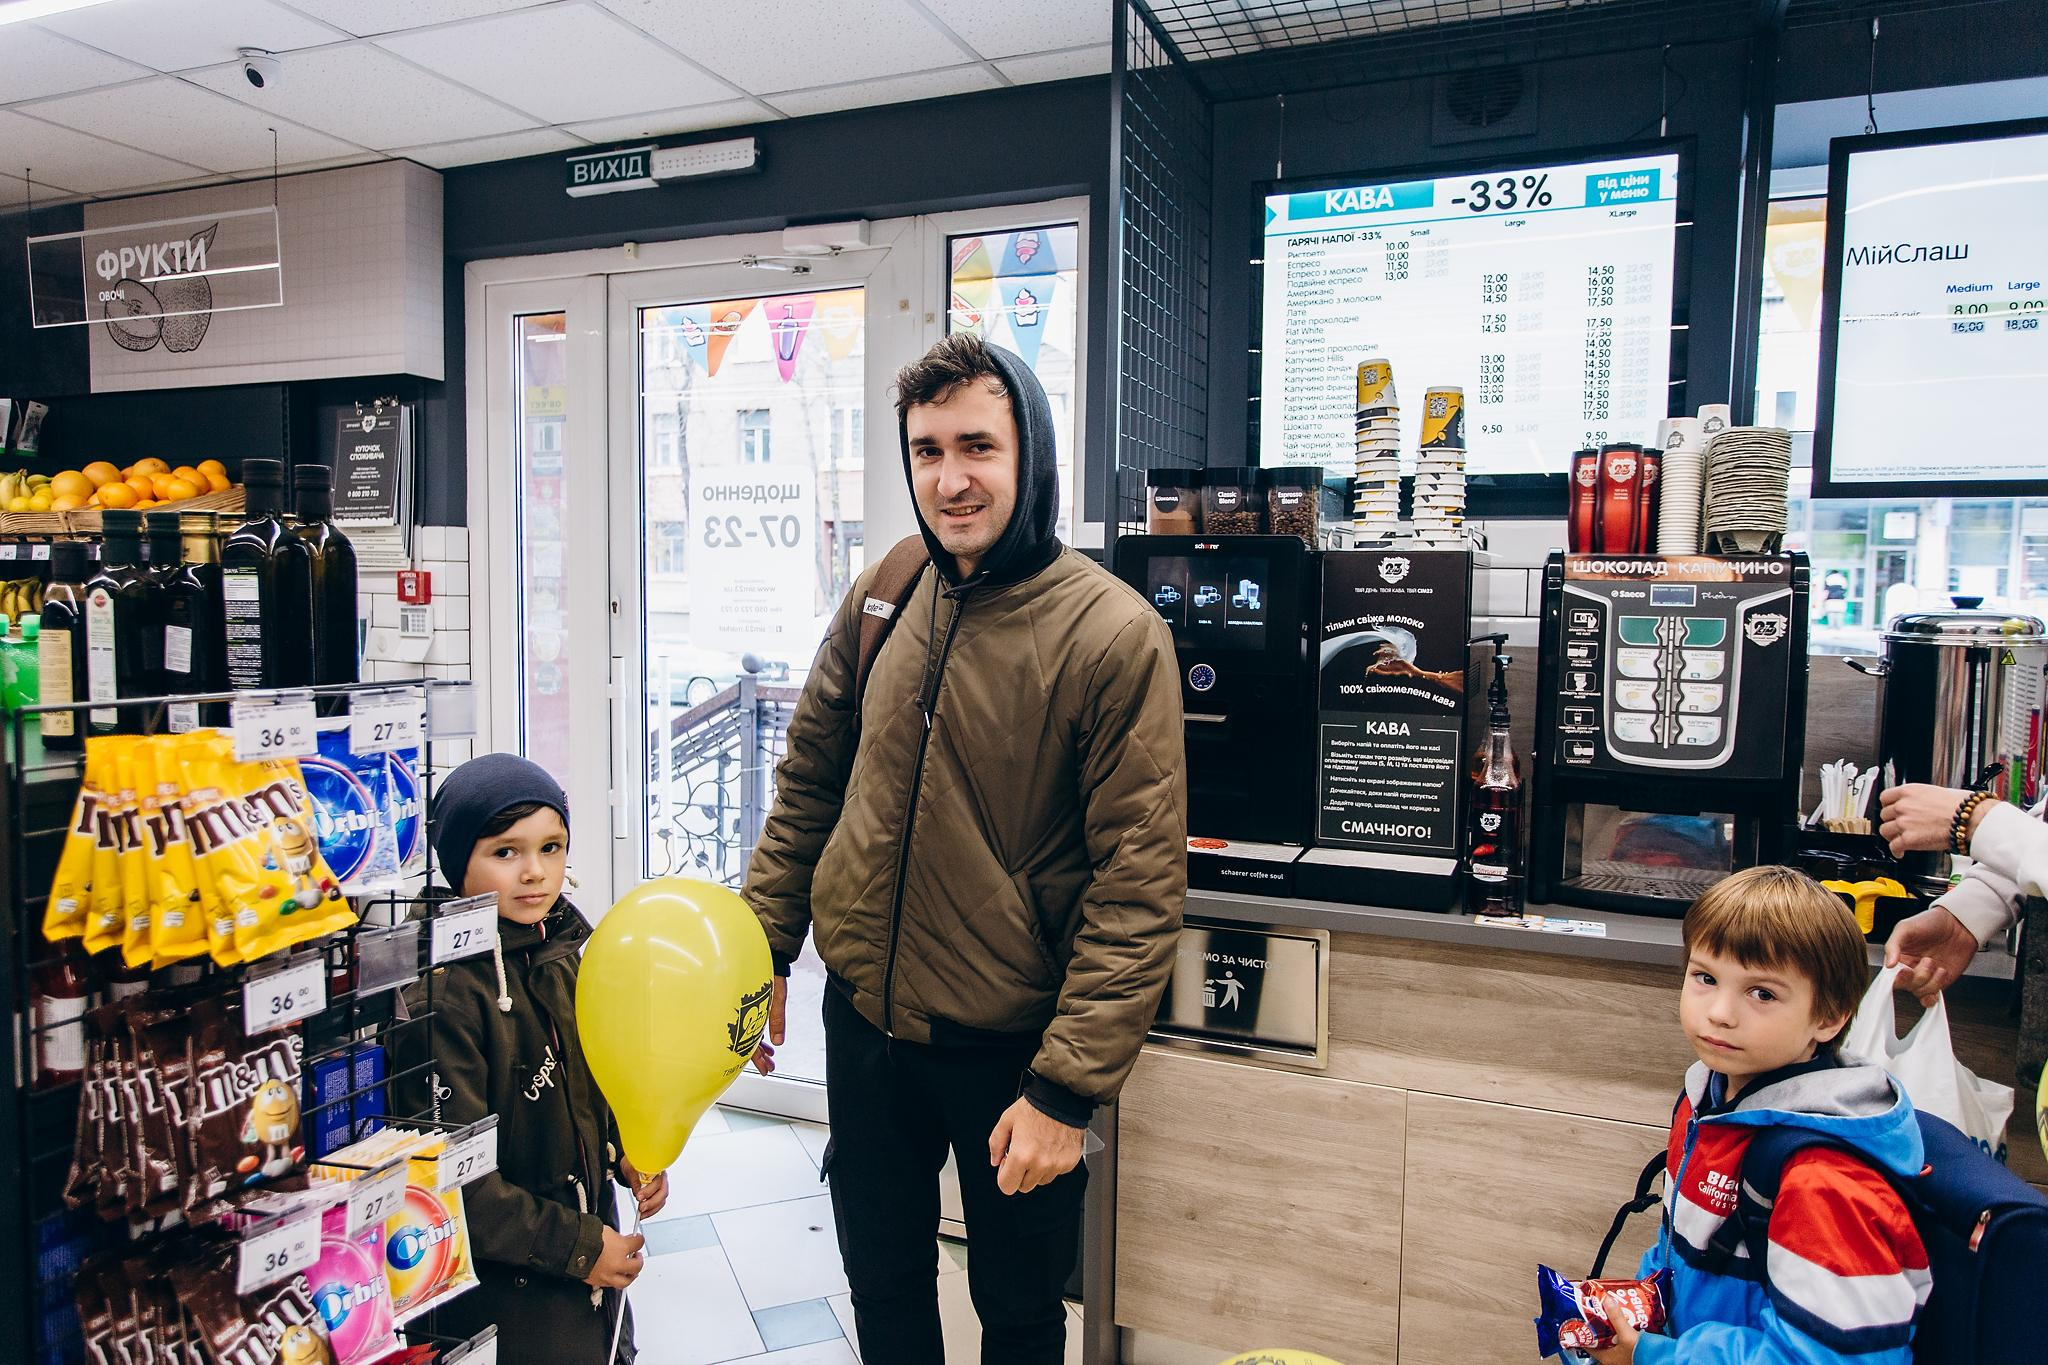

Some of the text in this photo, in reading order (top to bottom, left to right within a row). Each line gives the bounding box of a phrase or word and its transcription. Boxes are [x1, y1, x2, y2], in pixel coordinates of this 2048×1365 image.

[574, 155, 644, 184] ВИХІД
[1597, 174, 1650, 190] від ціни
[1451, 173, 1552, 212] -33%
[1600, 187, 1650, 203] у меню
[1324, 186, 1395, 214] КАВА
[1609, 208, 1637, 218] XLarge
[1504, 218, 1526, 228] Large
[1288, 231, 1382, 247] ГАРЯЧІ НАПОЇ -33%
[1410, 229, 1430, 237] Small
[96, 238, 206, 280] ФРУКТИ
[1846, 243, 1969, 268] МійСлаш
[1588, 265, 1614, 276] 14,50
[1483, 273, 1508, 284] 12,00
[1588, 276, 1614, 286] 16,00
[1483, 284, 1508, 294] 13,00
[1588, 286, 1614, 297] 17,50
[1946, 280, 2041, 294] Medium Large
[99, 290, 124, 302] ОВОЧІ
[1587, 296, 1614, 308] 17,50
[1482, 314, 1506, 324] 17,50
[1586, 317, 1612, 328] 17,50
[1952, 318, 2038, 333] 16,00 18,00
[1585, 348, 1611, 359] 14,50
[1584, 359, 1610, 369] 14,50
[1584, 369, 1610, 380] 14,50
[1584, 390, 1610, 400] 14,50
[1584, 400, 1609, 410] 17,50
[1582, 410, 1608, 420] 17,50
[1482, 424, 1502, 435] 9,50
[1586, 431, 1608, 442] 9,50
[1278, 491, 1302, 500] Espresso
[1573, 560, 1784, 577] ШОКОЛАД КАПУЧИНО
[1620, 590, 1646, 599] Saeco
[1325, 614, 1425, 632] тільки свіже молоко
[1340, 684, 1456, 708] 100% свіжомелена кава
[374, 722, 408, 741] 27 00
[1366, 721, 1411, 736] КАВА
[261, 727, 301, 748] 36 00
[1341, 820, 1432, 839] СМАЧНОГО!
[1221, 869, 1249, 878] schaerer
[1250, 871, 1269, 880] coffee
[453, 927, 484, 949] 27 00
[1222, 954, 1236, 965] ЗА
[272, 987, 310, 1014] 36 00
[457, 1151, 486, 1178] 27 00
[1706, 1170, 1739, 1192] Bla
[366, 1196, 384, 1220] 27
[386, 1216, 460, 1271] Orbit
[264, 1240, 305, 1272] 36 00
[312, 1272, 385, 1332] Orbit
